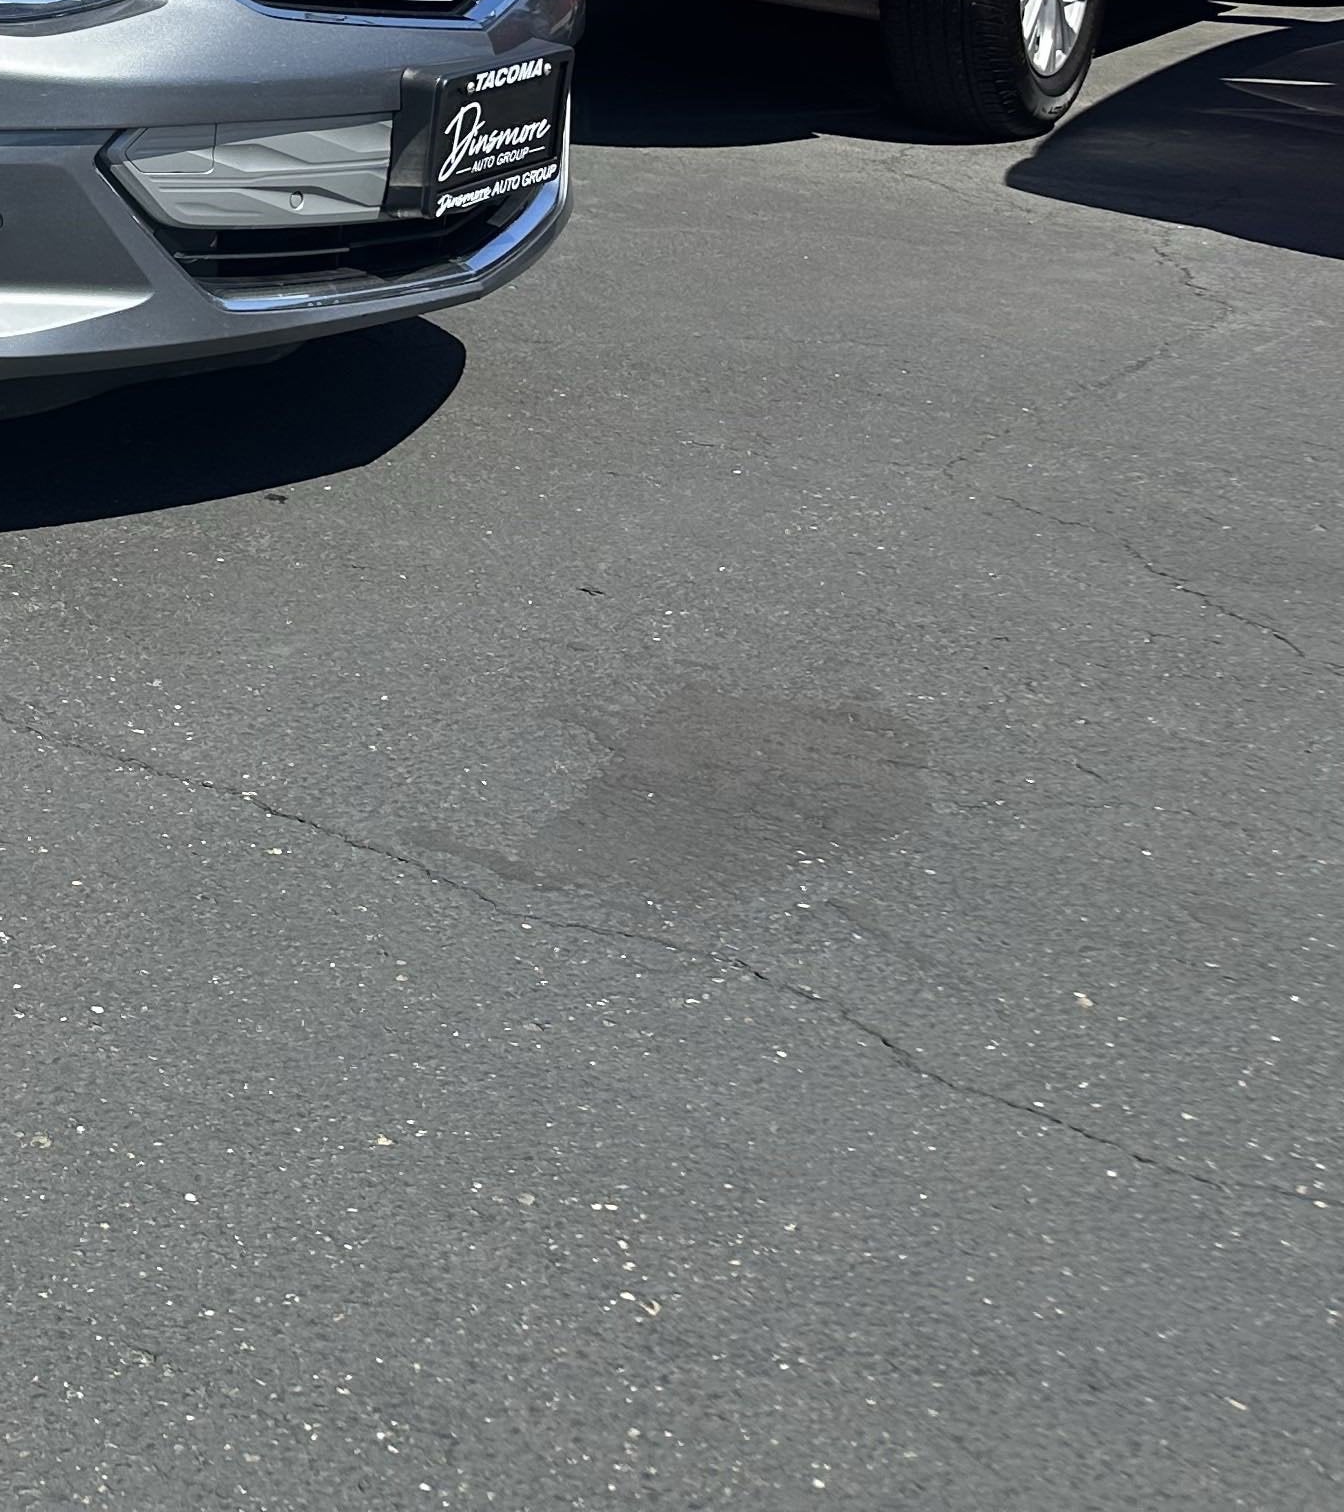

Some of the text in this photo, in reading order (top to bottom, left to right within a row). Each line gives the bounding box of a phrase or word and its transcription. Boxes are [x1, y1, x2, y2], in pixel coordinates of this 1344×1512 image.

[474, 58, 543, 92] TACOMA
[438, 101, 551, 182] Dinsmore
[470, 146, 530, 173] AUTO GROUP
[436, 163, 558, 218] Dinsmore AUTO GROUP
